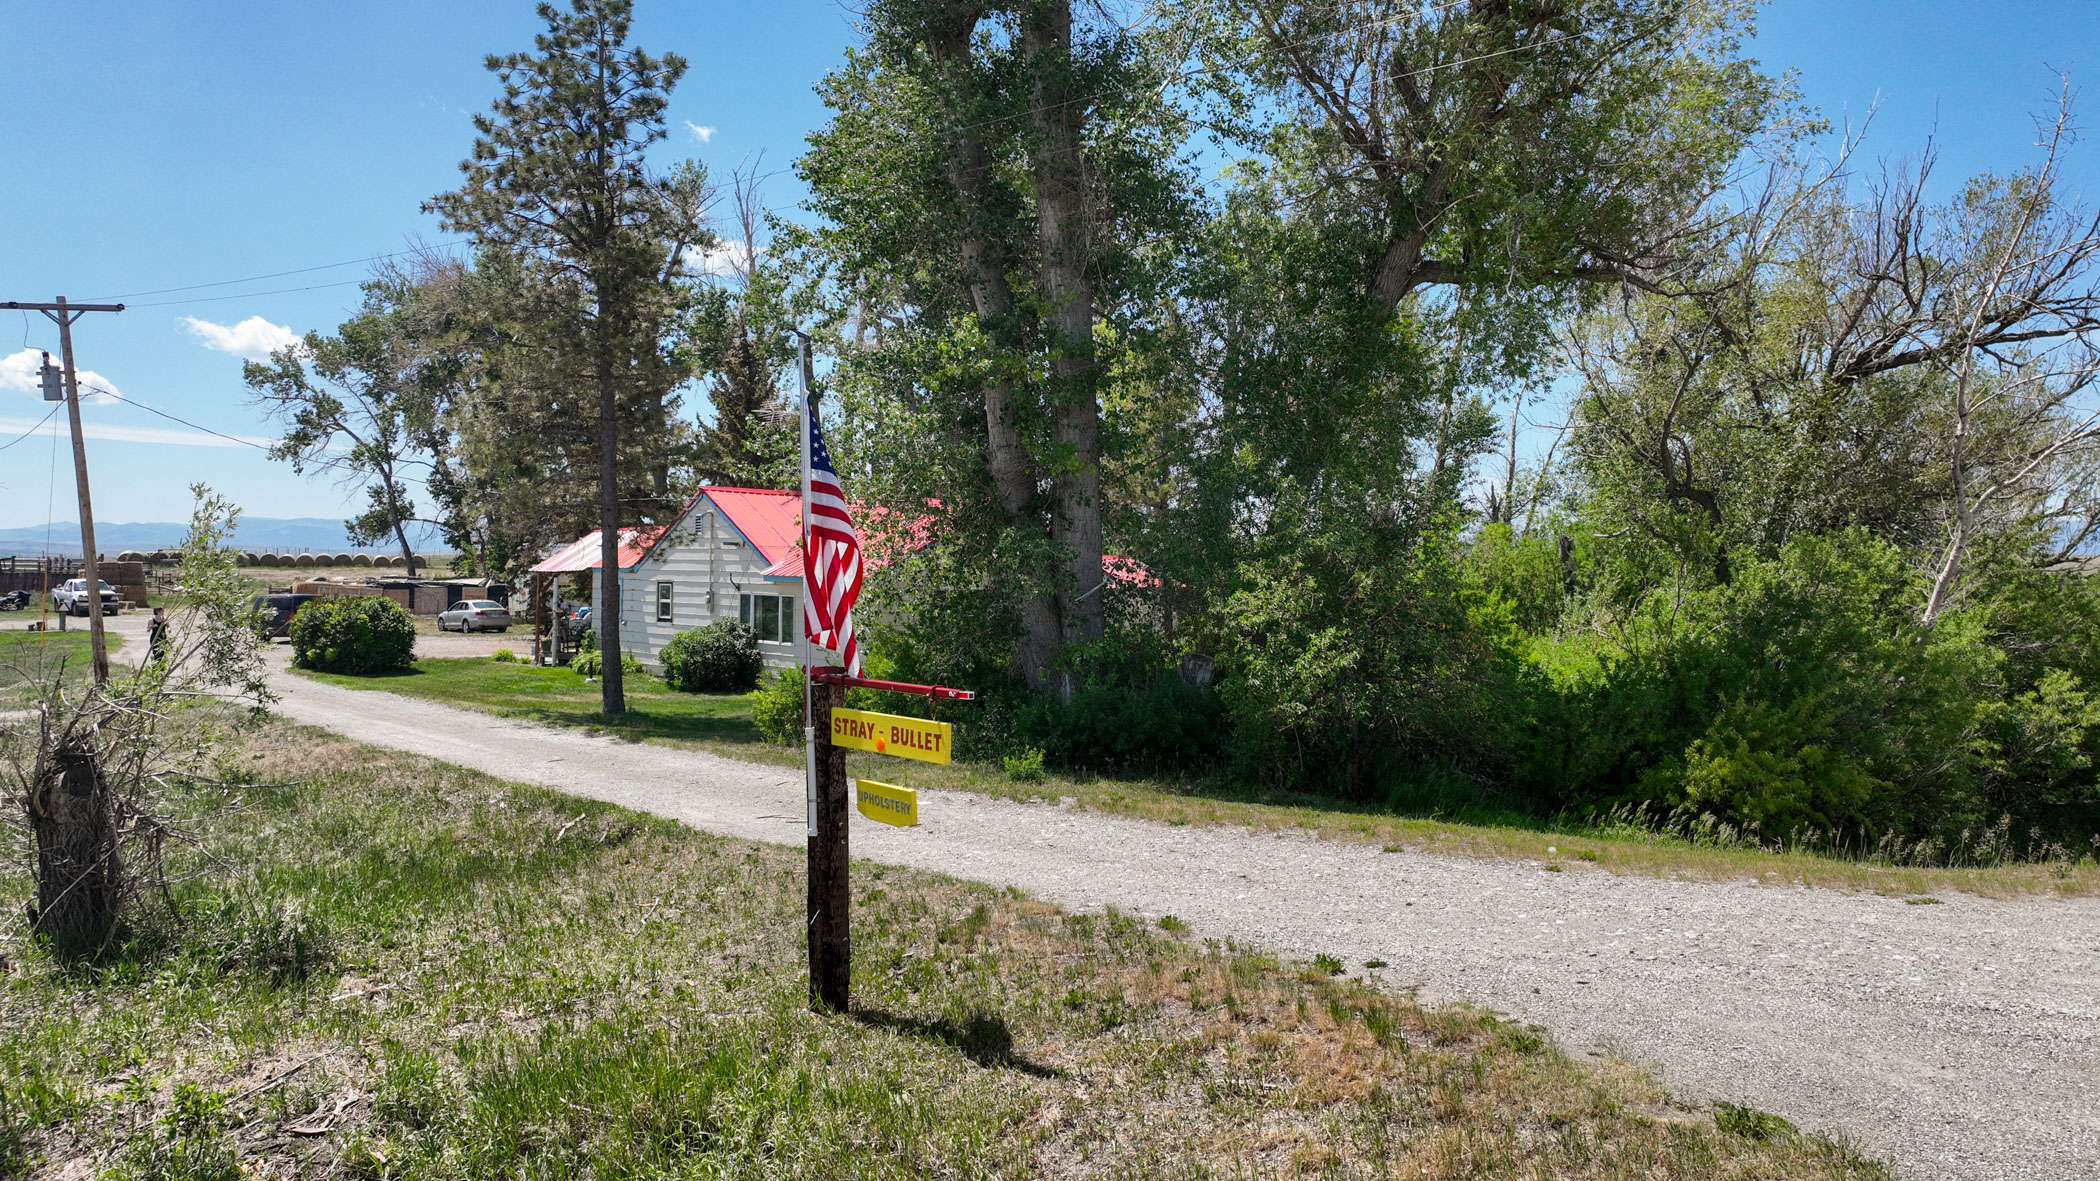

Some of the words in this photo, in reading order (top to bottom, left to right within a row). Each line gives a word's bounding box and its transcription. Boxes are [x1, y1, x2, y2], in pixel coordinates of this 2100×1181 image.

[834, 717, 875, 740] STRAY
[891, 726, 942, 752] BULLET
[858, 790, 911, 815] UPHOLSTERY
